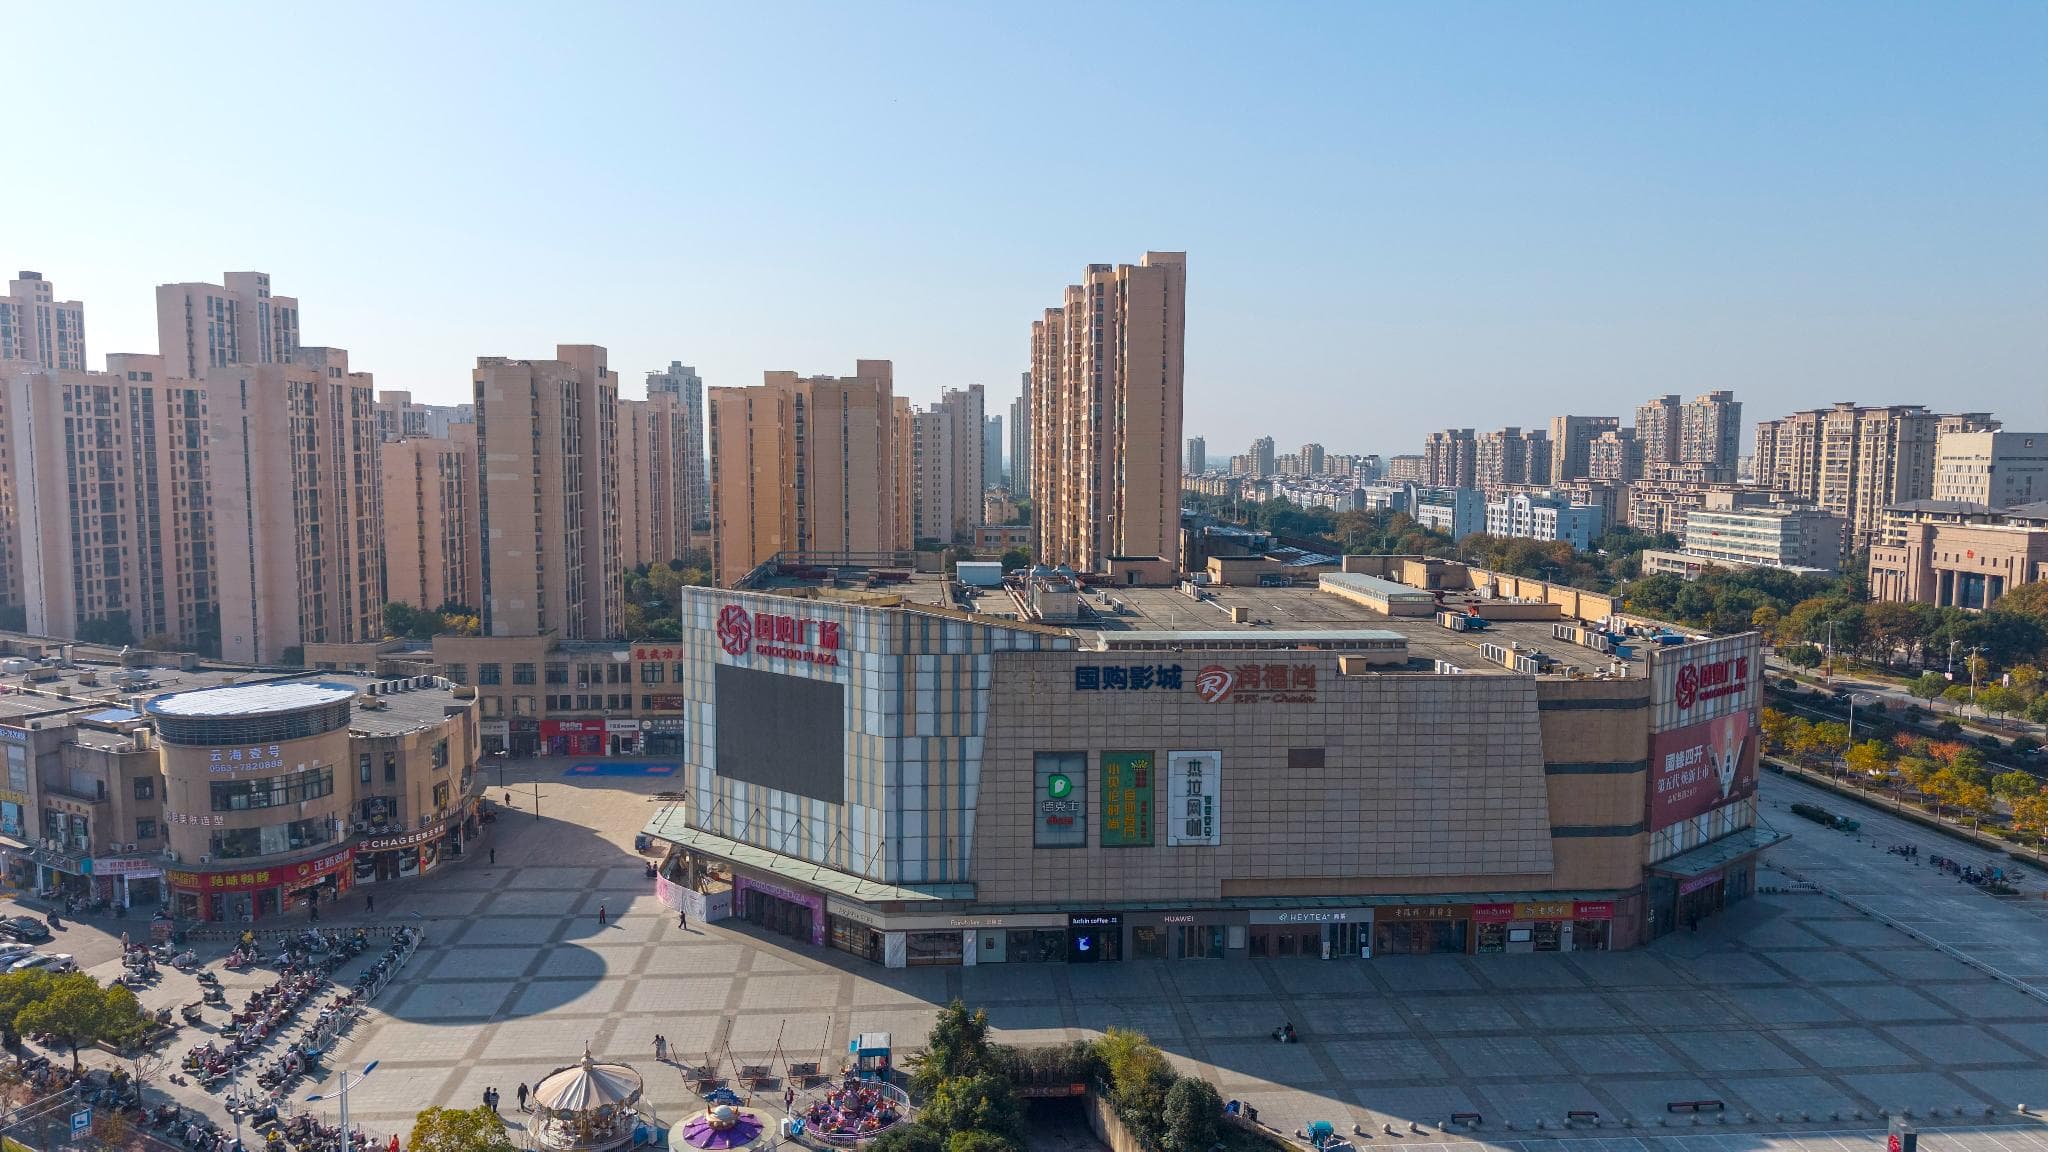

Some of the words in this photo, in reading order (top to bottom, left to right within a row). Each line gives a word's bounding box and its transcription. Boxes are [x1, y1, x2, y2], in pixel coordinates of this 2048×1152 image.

[754, 612, 840, 650] 国购广场
[756, 644, 803, 662] GOOCOO
[803, 650, 840, 666] PLAZA
[1075, 664, 1183, 691] 国购影城
[1235, 663, 1317, 689] 润福尚
[209, 745, 281, 762] 云海壹号
[1042, 800, 1081, 812] 德克士
[1186, 759, 1202, 837] 杰拉网咖
[371, 833, 421, 848] CHAGEE
[1164, 915, 1194, 923] HUAWEI
[1290, 913, 1327, 921] HEYTEA
